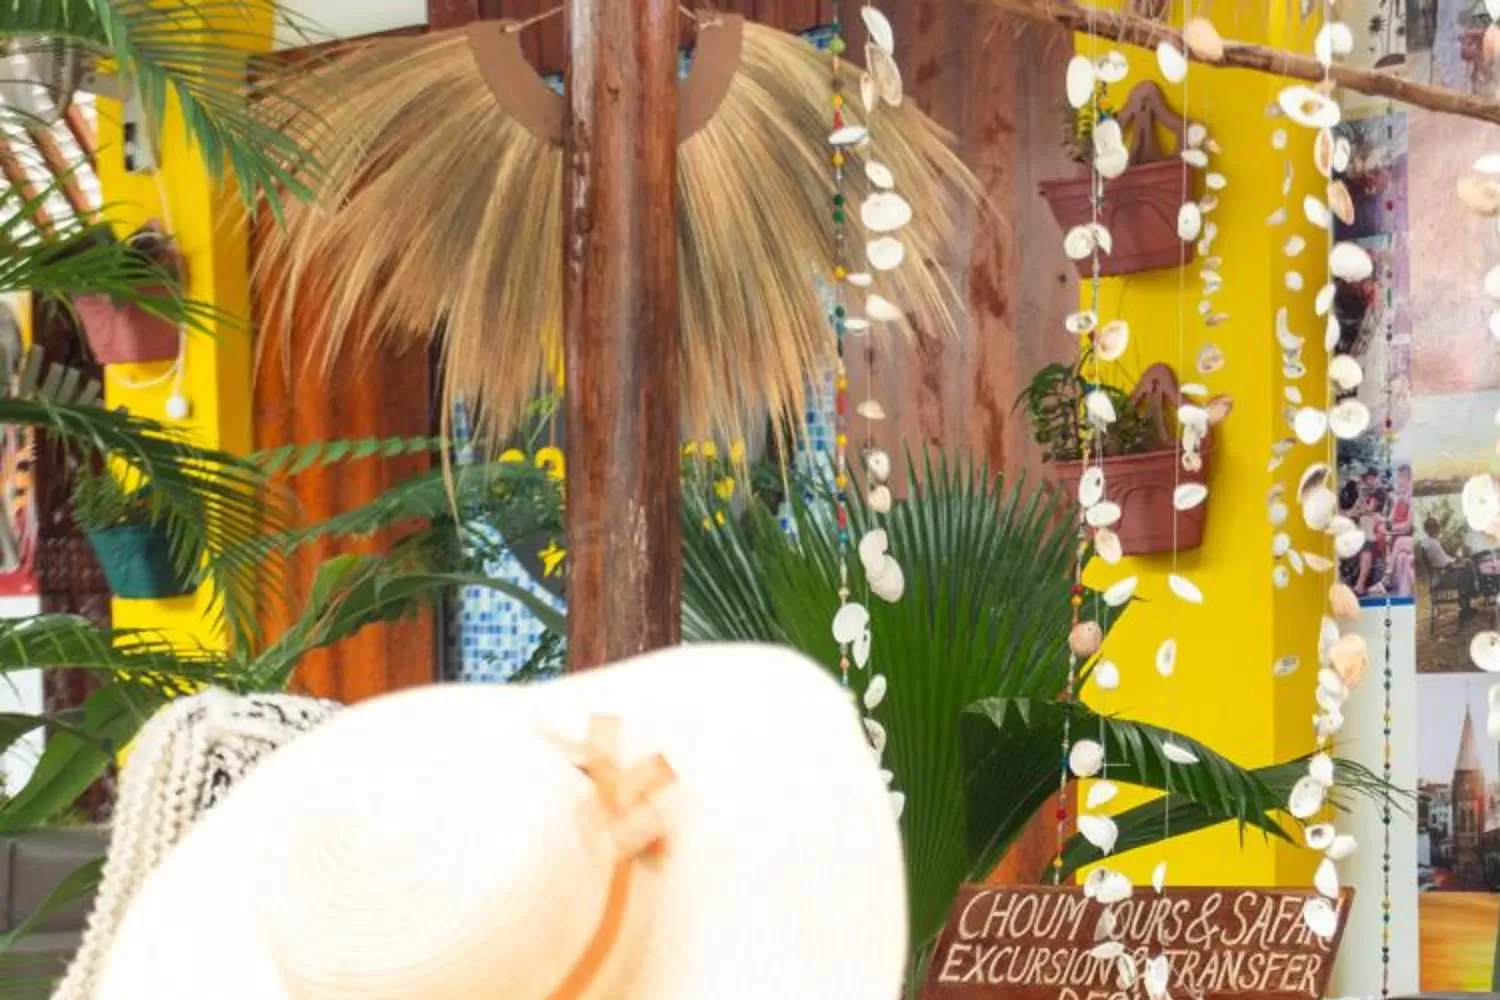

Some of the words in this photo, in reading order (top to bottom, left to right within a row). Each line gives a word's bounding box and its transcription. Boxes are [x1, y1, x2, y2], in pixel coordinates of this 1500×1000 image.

[958, 890, 1089, 941] CHOUM
[1094, 897, 1192, 946] OURS
[1185, 892, 1223, 950] &
[938, 942, 1115, 986] EXCURSION
[1162, 948, 1322, 999] TRANSFER
